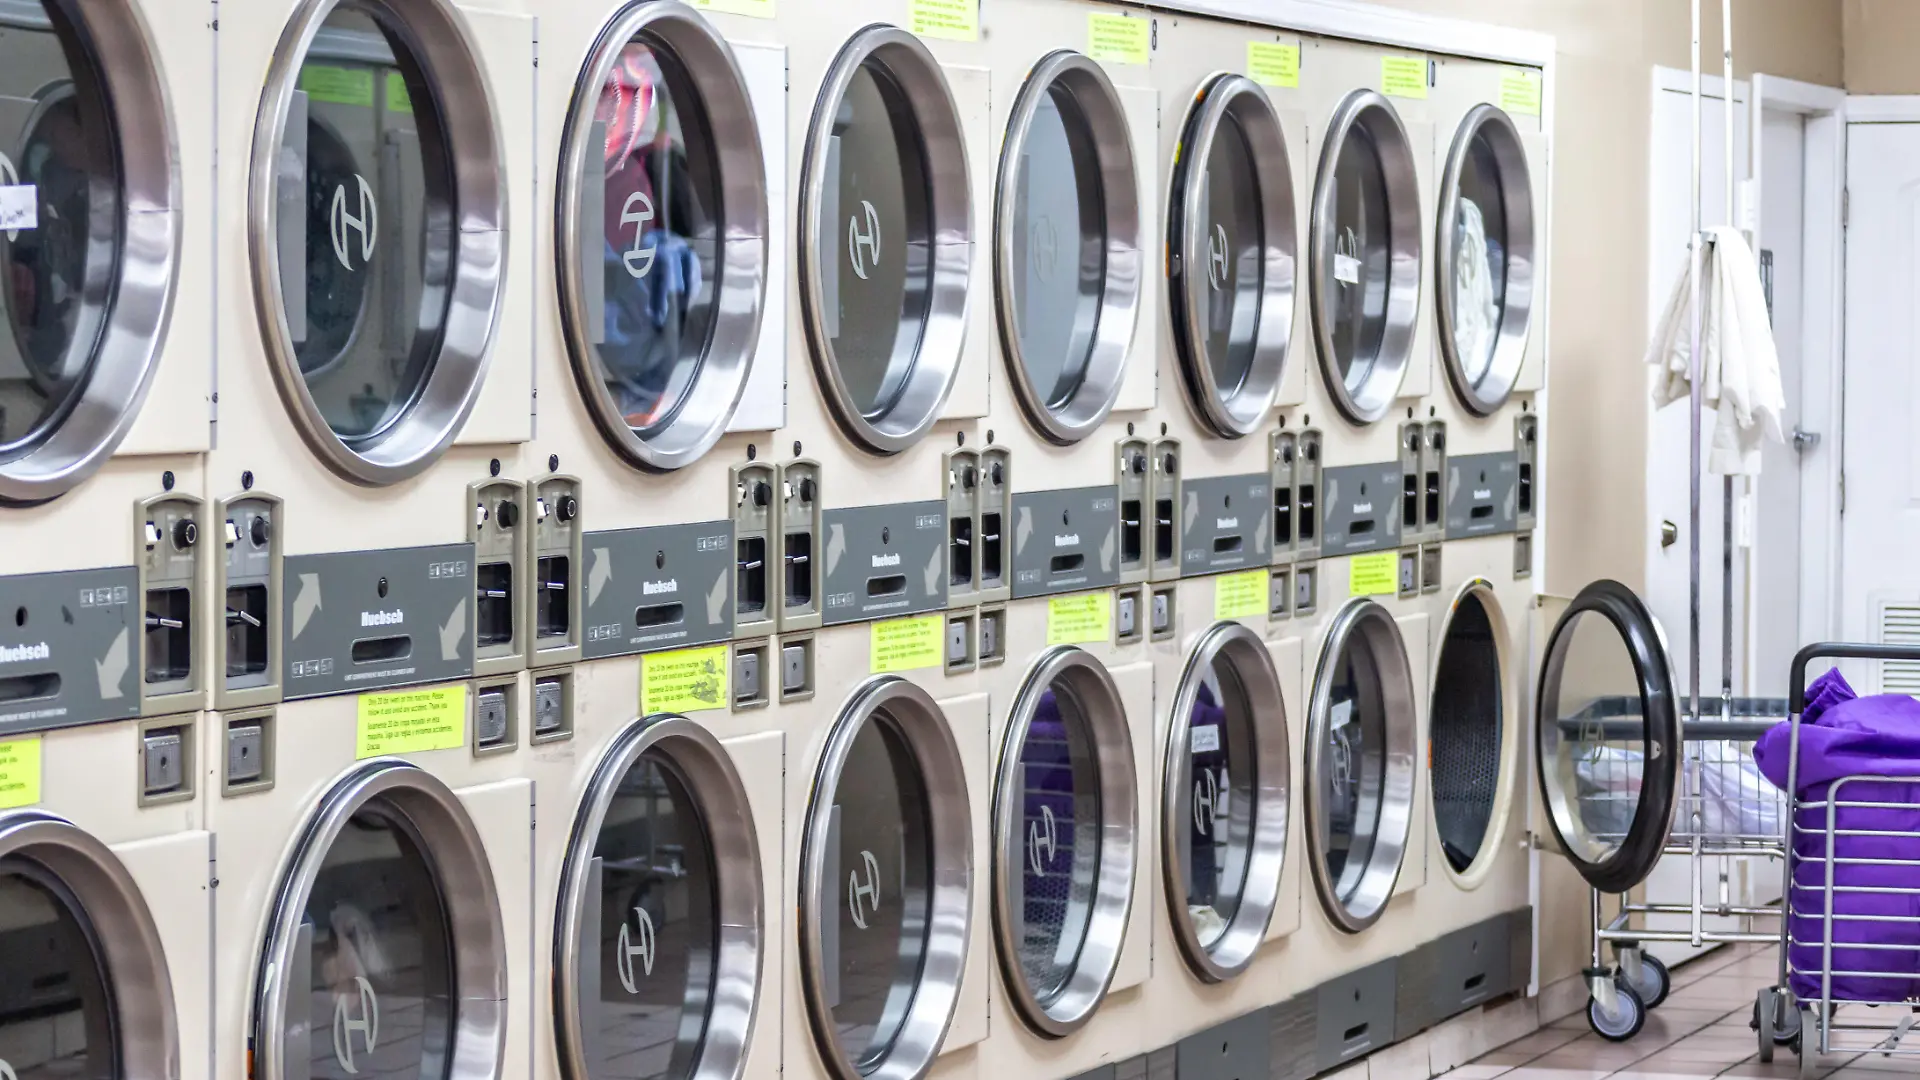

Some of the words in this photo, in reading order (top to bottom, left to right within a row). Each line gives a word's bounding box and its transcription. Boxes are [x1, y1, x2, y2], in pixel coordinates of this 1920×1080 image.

[849, 200, 881, 280] H
[361, 608, 403, 626] Huebsch
[643, 578, 677, 594] Huebsch
[1030, 805, 1055, 877] H
[849, 850, 880, 929] H
[617, 906, 654, 994] H
[333, 976, 378, 1074] H
